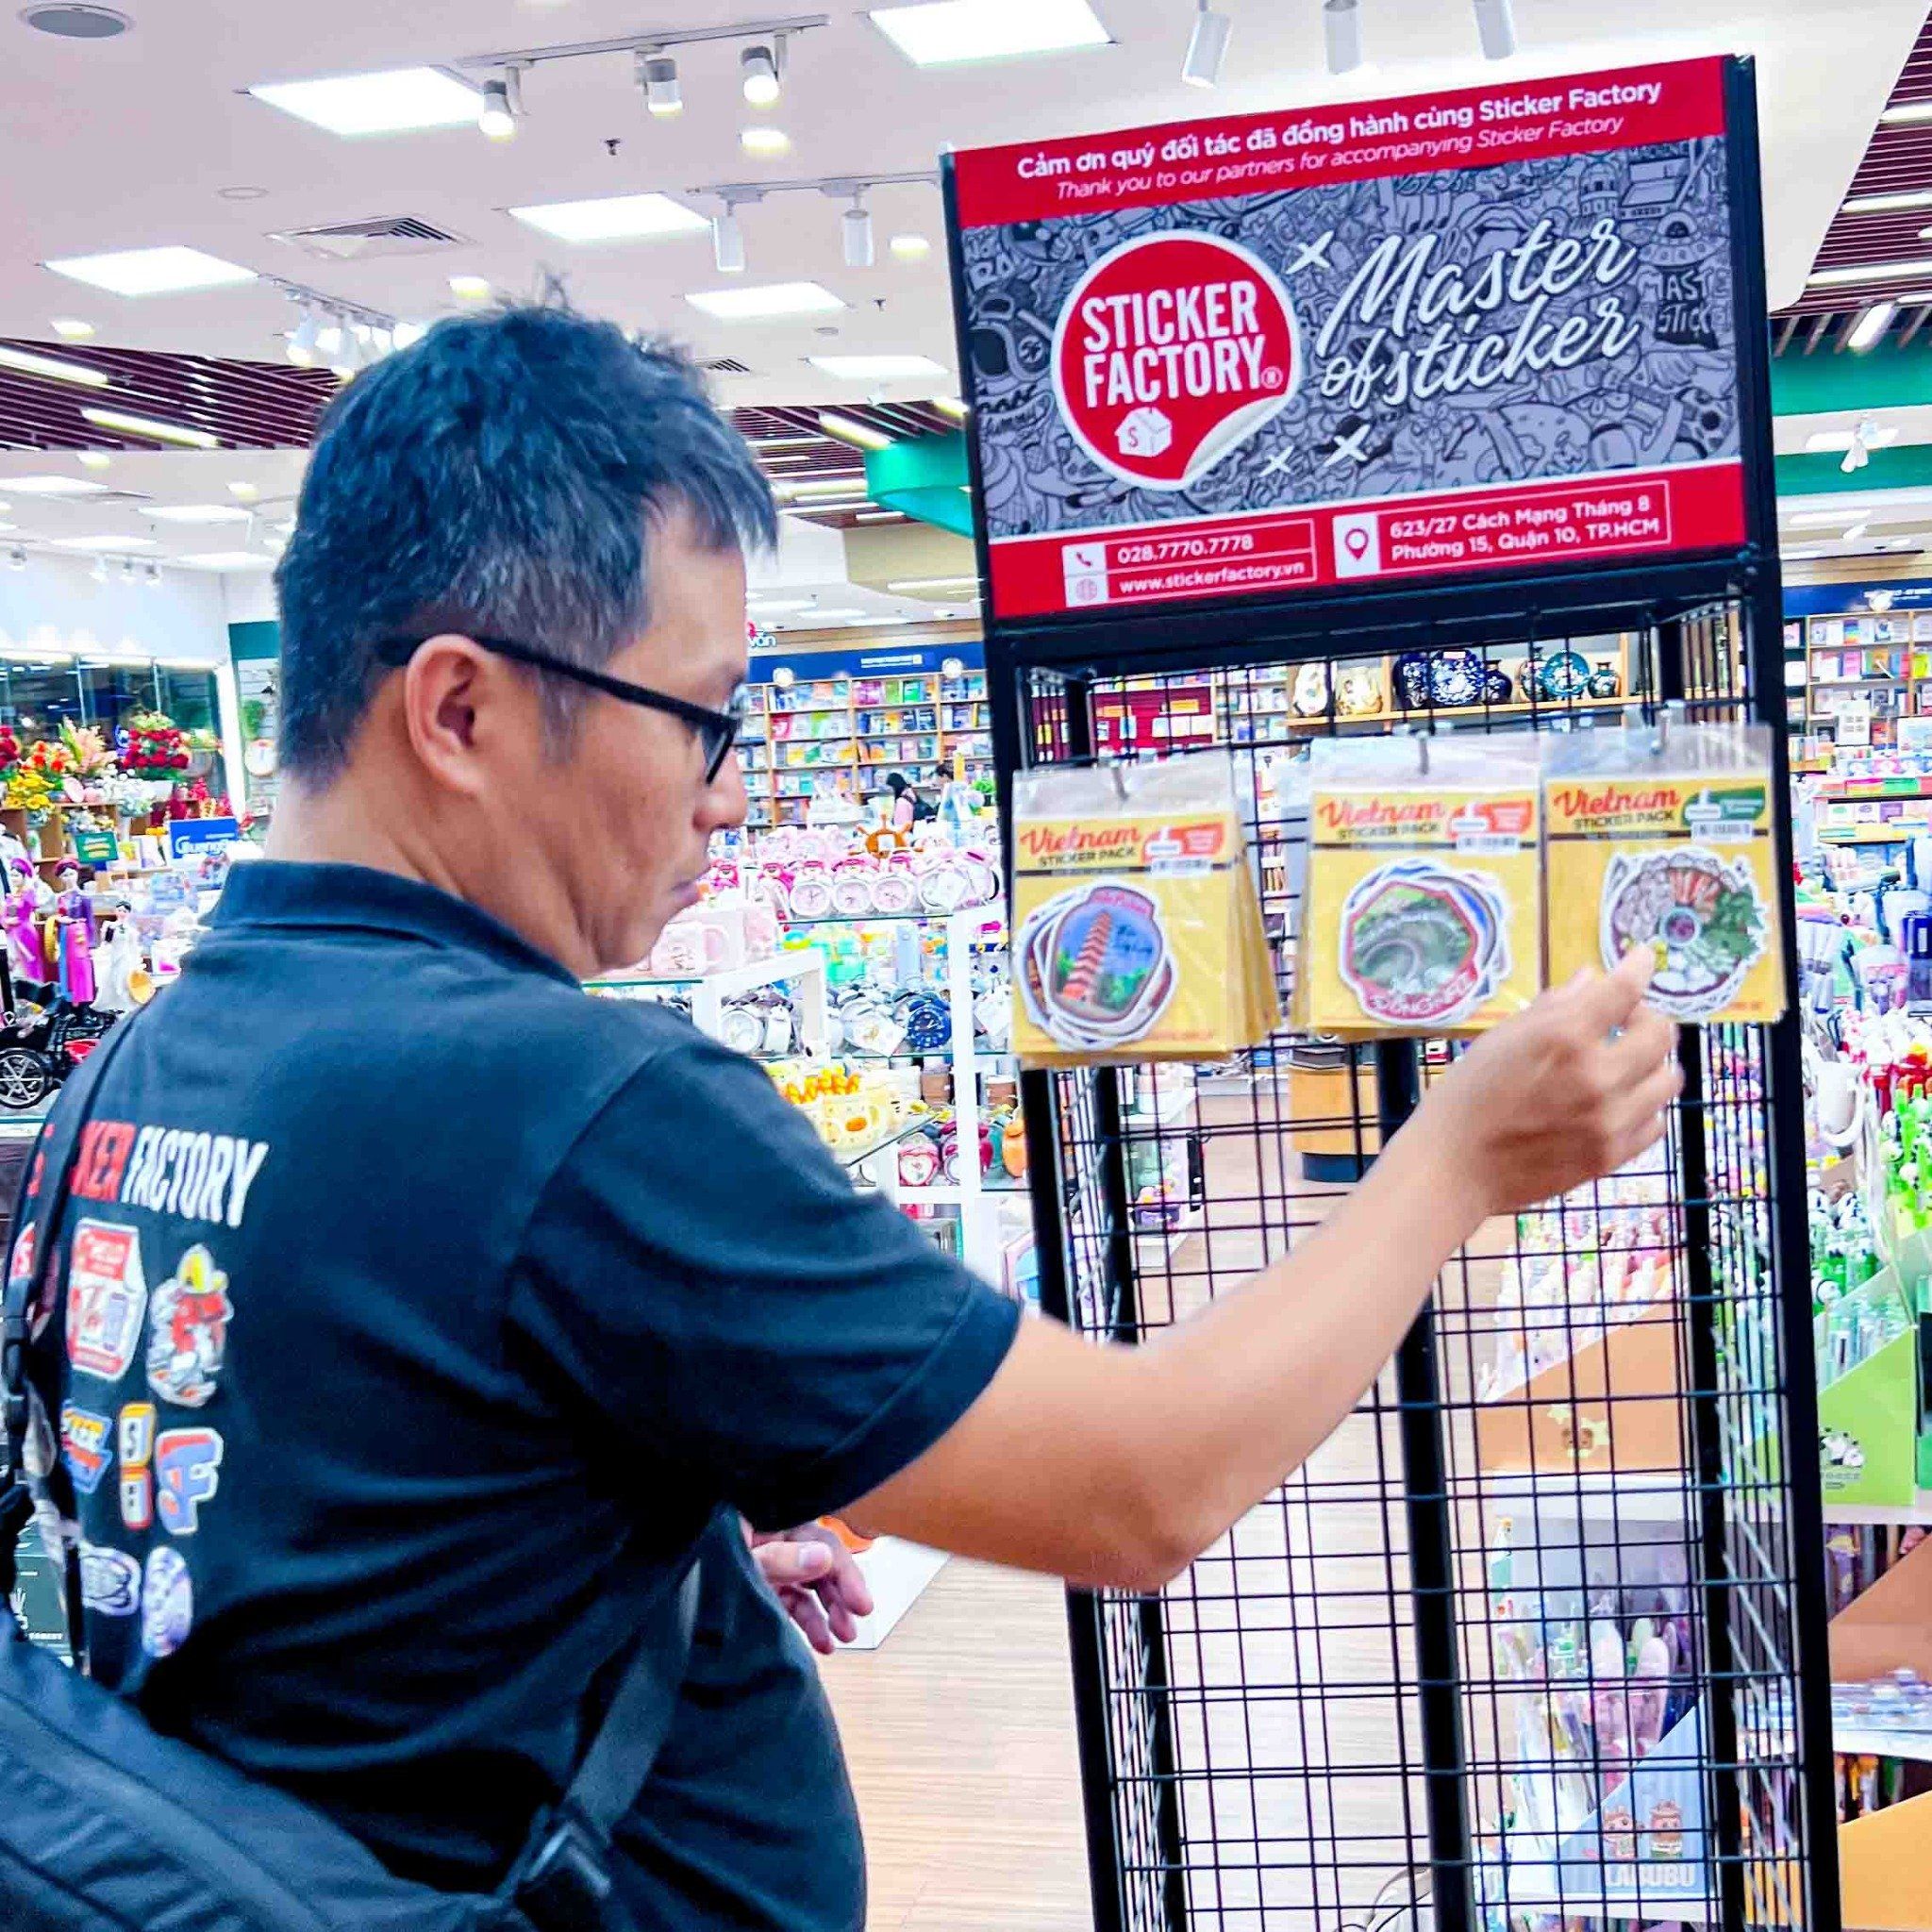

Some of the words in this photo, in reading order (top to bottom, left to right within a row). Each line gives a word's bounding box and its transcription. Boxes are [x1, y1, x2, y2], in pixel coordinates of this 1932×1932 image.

[1017, 152, 1071, 178] Cảm
[1075, 151, 1107, 172] ơn
[1111, 142, 1156, 169] quý
[1160, 132, 1199, 161] đối
[1204, 129, 1241, 156] tác
[1246, 126, 1277, 151] đã
[1282, 118, 1344, 146] đồng
[1349, 111, 1408, 139] hành
[1413, 105, 1474, 131] cùng
[1478, 94, 1563, 123] Sticker
[1568, 81, 1662, 111] Factory
[1057, 177, 1112, 201] Thank
[1116, 174, 1152, 196] you
[1157, 171, 1176, 188] to
[1180, 167, 1210, 185] our
[1215, 157, 1295, 185] partners
[1300, 151, 1328, 172] for
[1331, 133, 1473, 168] accompanying
[1476, 121, 1544, 149] Sticker
[1547, 114, 1624, 140] Factory
[1316, 218, 1638, 358] Master
[1081, 279, 1260, 353] STICKER
[1321, 327, 1387, 408] of
[1382, 293, 1641, 408] sticker
[1390, 515, 1457, 540] 623/27
[1462, 507, 1511, 530] Cách
[1515, 505, 1567, 528] Mạng
[1572, 497, 1634, 521] Tháng
[1638, 494, 1651, 512] 8
[1391, 536, 1464, 561] Phường
[1468, 536, 1494, 555] 15,
[1497, 528, 1550, 552] Quận
[1554, 526, 1582, 544] 10,
[1586, 518, 1660, 541] TP.HCM
[1117, 534, 1255, 564] 028.7770.7778
[1119, 560, 1306, 594] www.stickerfactory.vn
[1318, 797, 1446, 828] Vietnam
[1554, 785, 1682, 818] Vietnam
[1020, 825, 1141, 857] Vietnam
[121, 1124, 270, 1229] FACTORY
